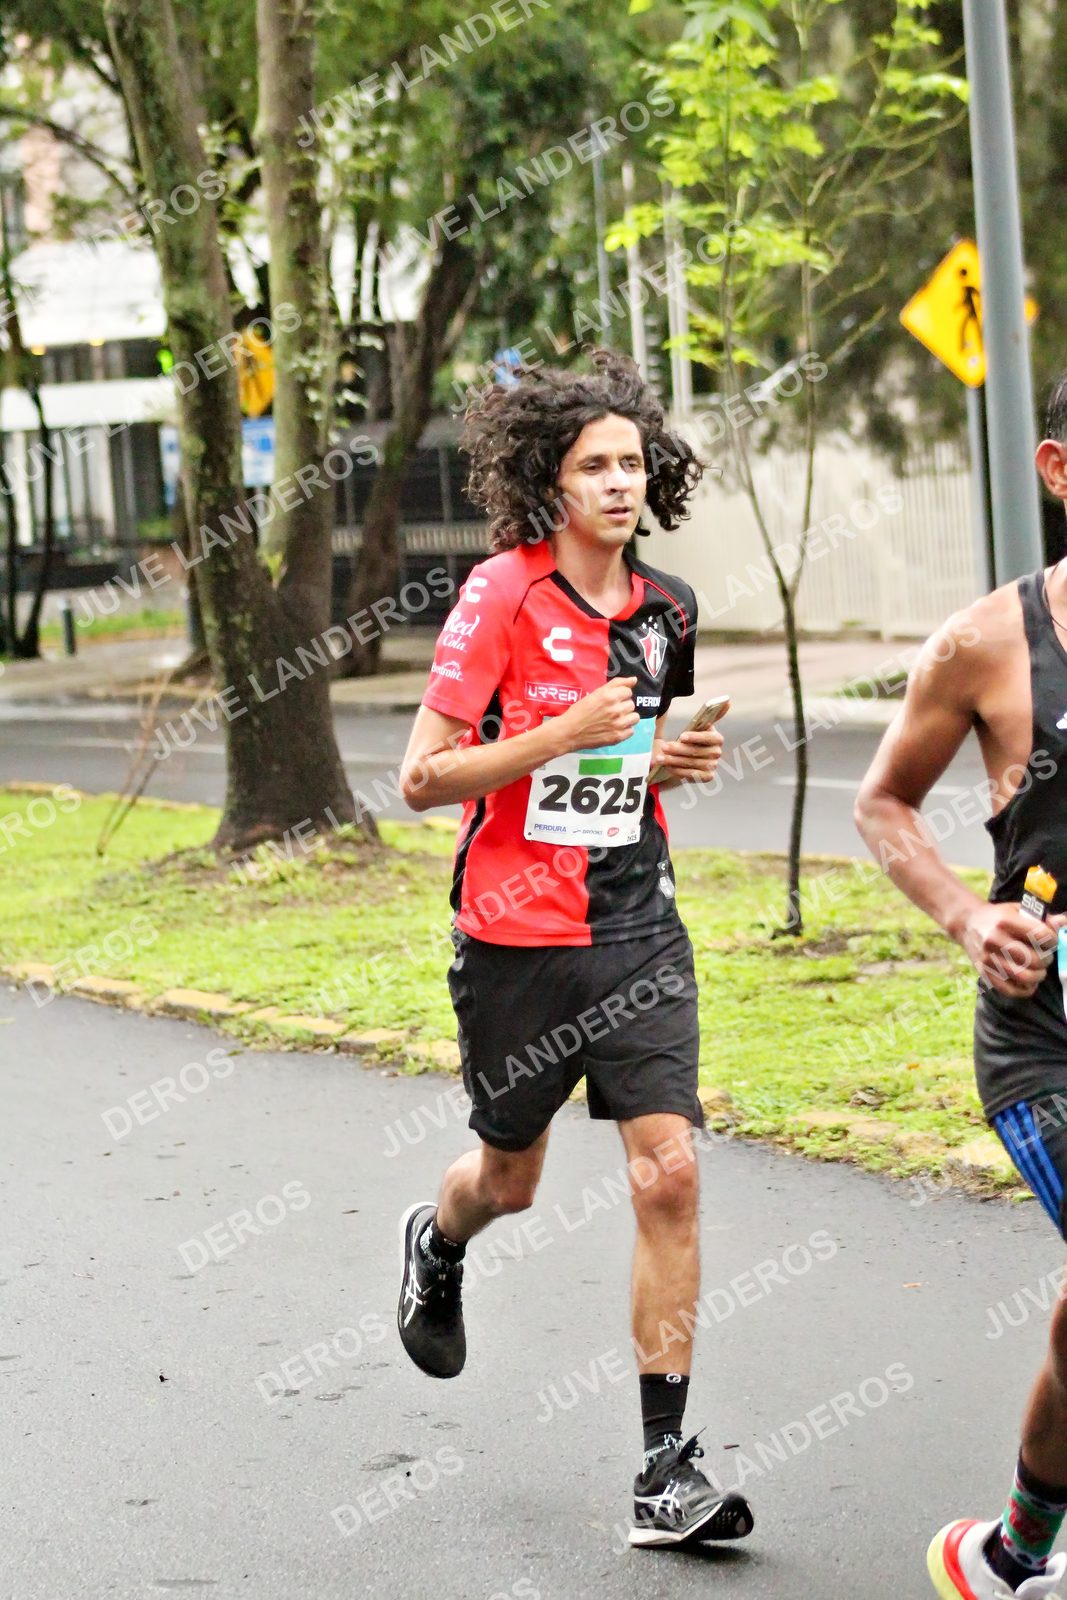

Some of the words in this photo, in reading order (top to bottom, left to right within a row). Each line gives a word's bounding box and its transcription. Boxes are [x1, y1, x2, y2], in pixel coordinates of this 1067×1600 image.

[443, 612, 480, 638] Red
[443, 634, 467, 651] Cola
[528, 685, 577, 703] URREA
[538, 775, 643, 816] 2625
[534, 823, 567, 833] PERDURA
